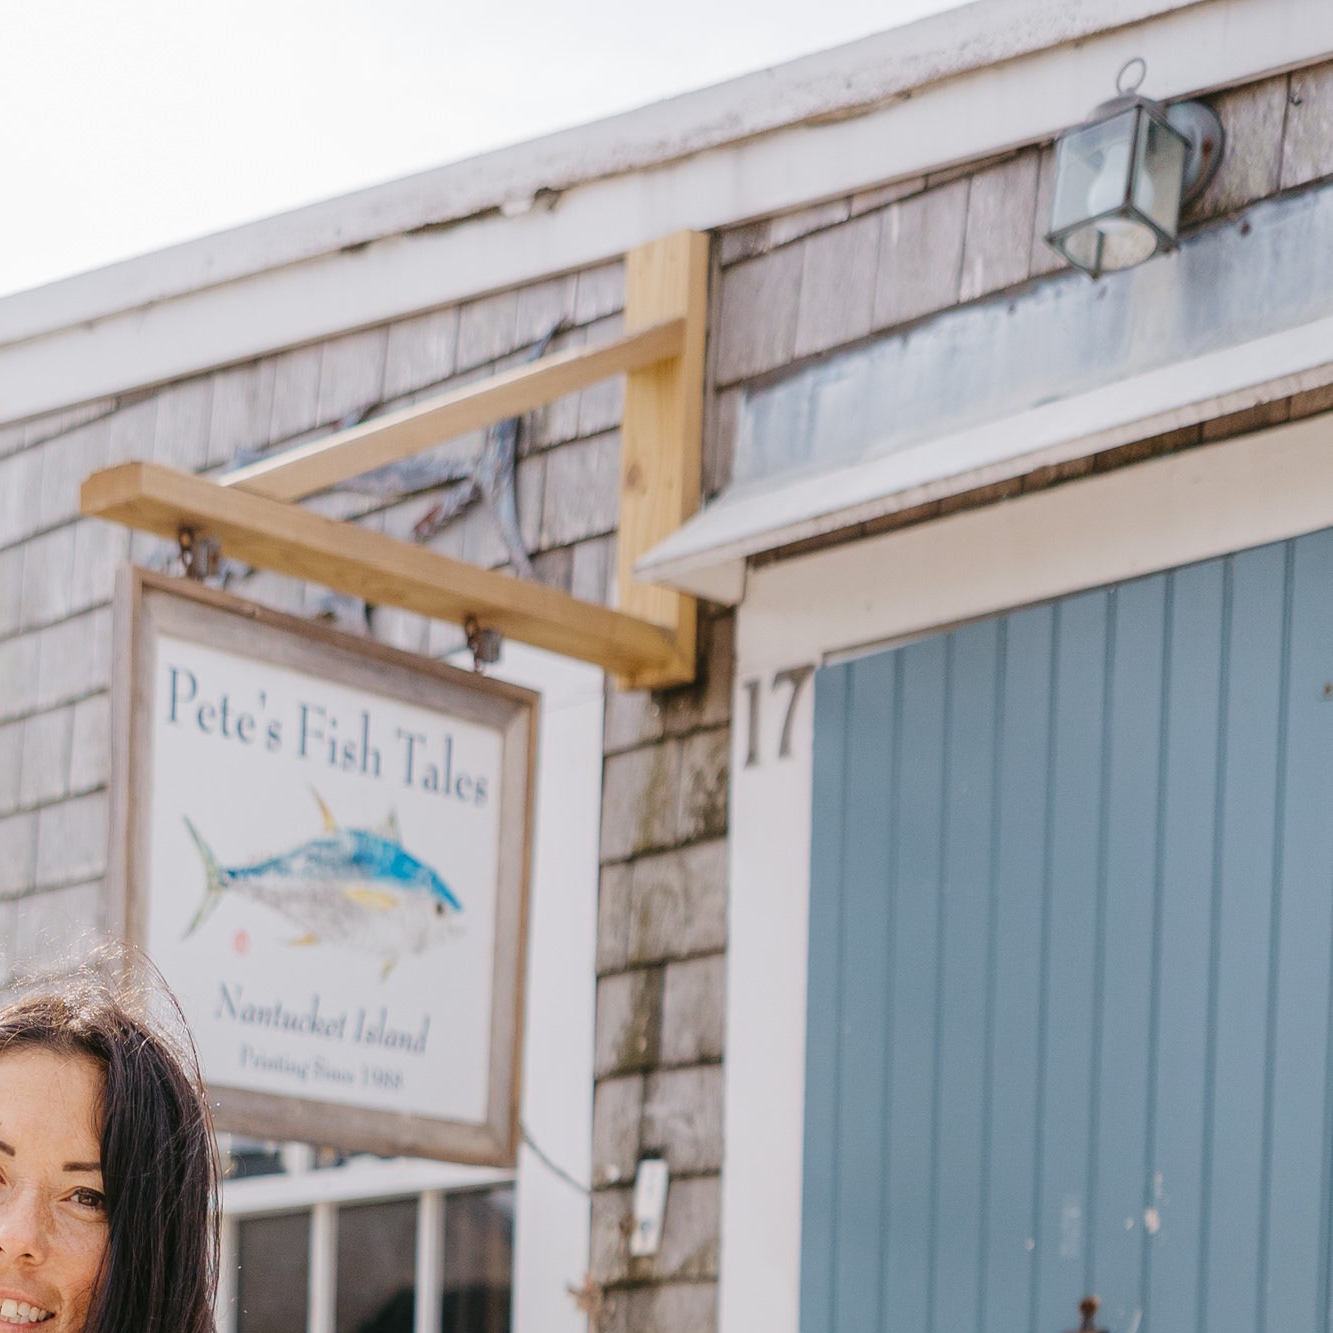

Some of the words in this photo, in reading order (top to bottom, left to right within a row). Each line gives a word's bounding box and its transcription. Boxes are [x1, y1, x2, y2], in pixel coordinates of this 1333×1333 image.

[167, 666, 282, 752] Pete's
[297, 702, 381, 778] Fish
[397, 729, 489, 805] Tales
[743, 663, 816, 769] 17
[214, 981, 348, 1038] Nantucket
[353, 1006, 431, 1055] Island
